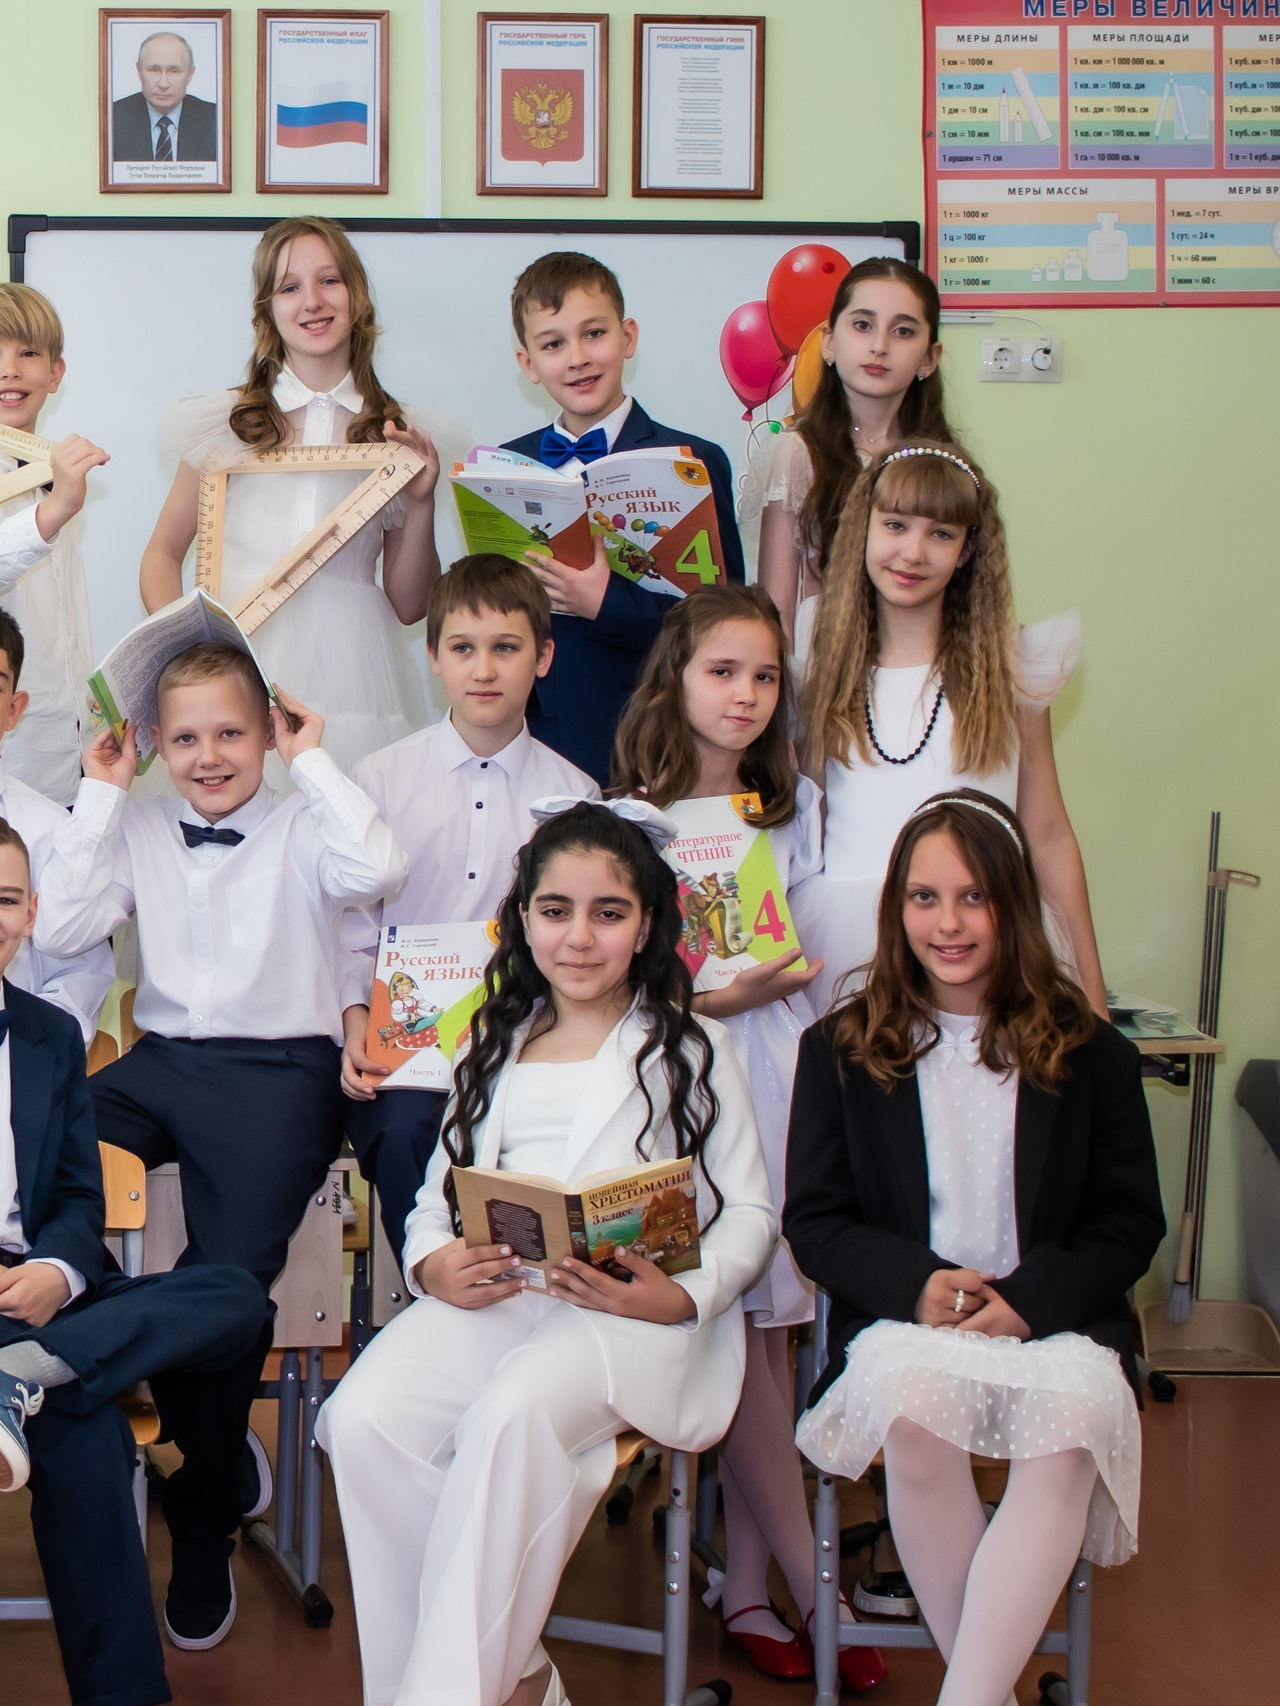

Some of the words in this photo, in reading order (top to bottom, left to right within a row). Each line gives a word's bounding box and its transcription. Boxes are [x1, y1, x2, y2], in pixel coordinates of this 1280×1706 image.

[1023, 0, 1116, 18] МЕРЫ
[1132, 0, 1280, 17] ВЕЛИЧИН
[956, 34, 990, 43] МЕРЫ
[994, 34, 1038, 44] ДЛИНЫ
[1092, 34, 1125, 42] МЕРЫ
[1130, 34, 1189, 44] ПЛОЩАДИ
[1258, 34, 1280, 42] МЕР
[948, 156, 974, 164] аршин
[983, 154, 991, 162] 71
[1007, 187, 1042, 196] МЕРЫ
[1046, 187, 1088, 195] МАССЫ
[1228, 186, 1261, 194] МЕРЫ
[585, 487, 657, 509] Русский
[675, 530, 720, 584] 4
[677, 846, 734, 863] ЧТЕНИЕ
[753, 890, 786, 942] 4
[384, 952, 460, 970] Русский
[715, 968, 738, 977] Часть
[589, 1180, 638, 1200] НОВЕЙШАЯ
[590, 1170, 691, 1211] ХРЕСТОМАТИЯ
[593, 1215, 600, 1225] 3
[602, 1208, 634, 1222] класс
